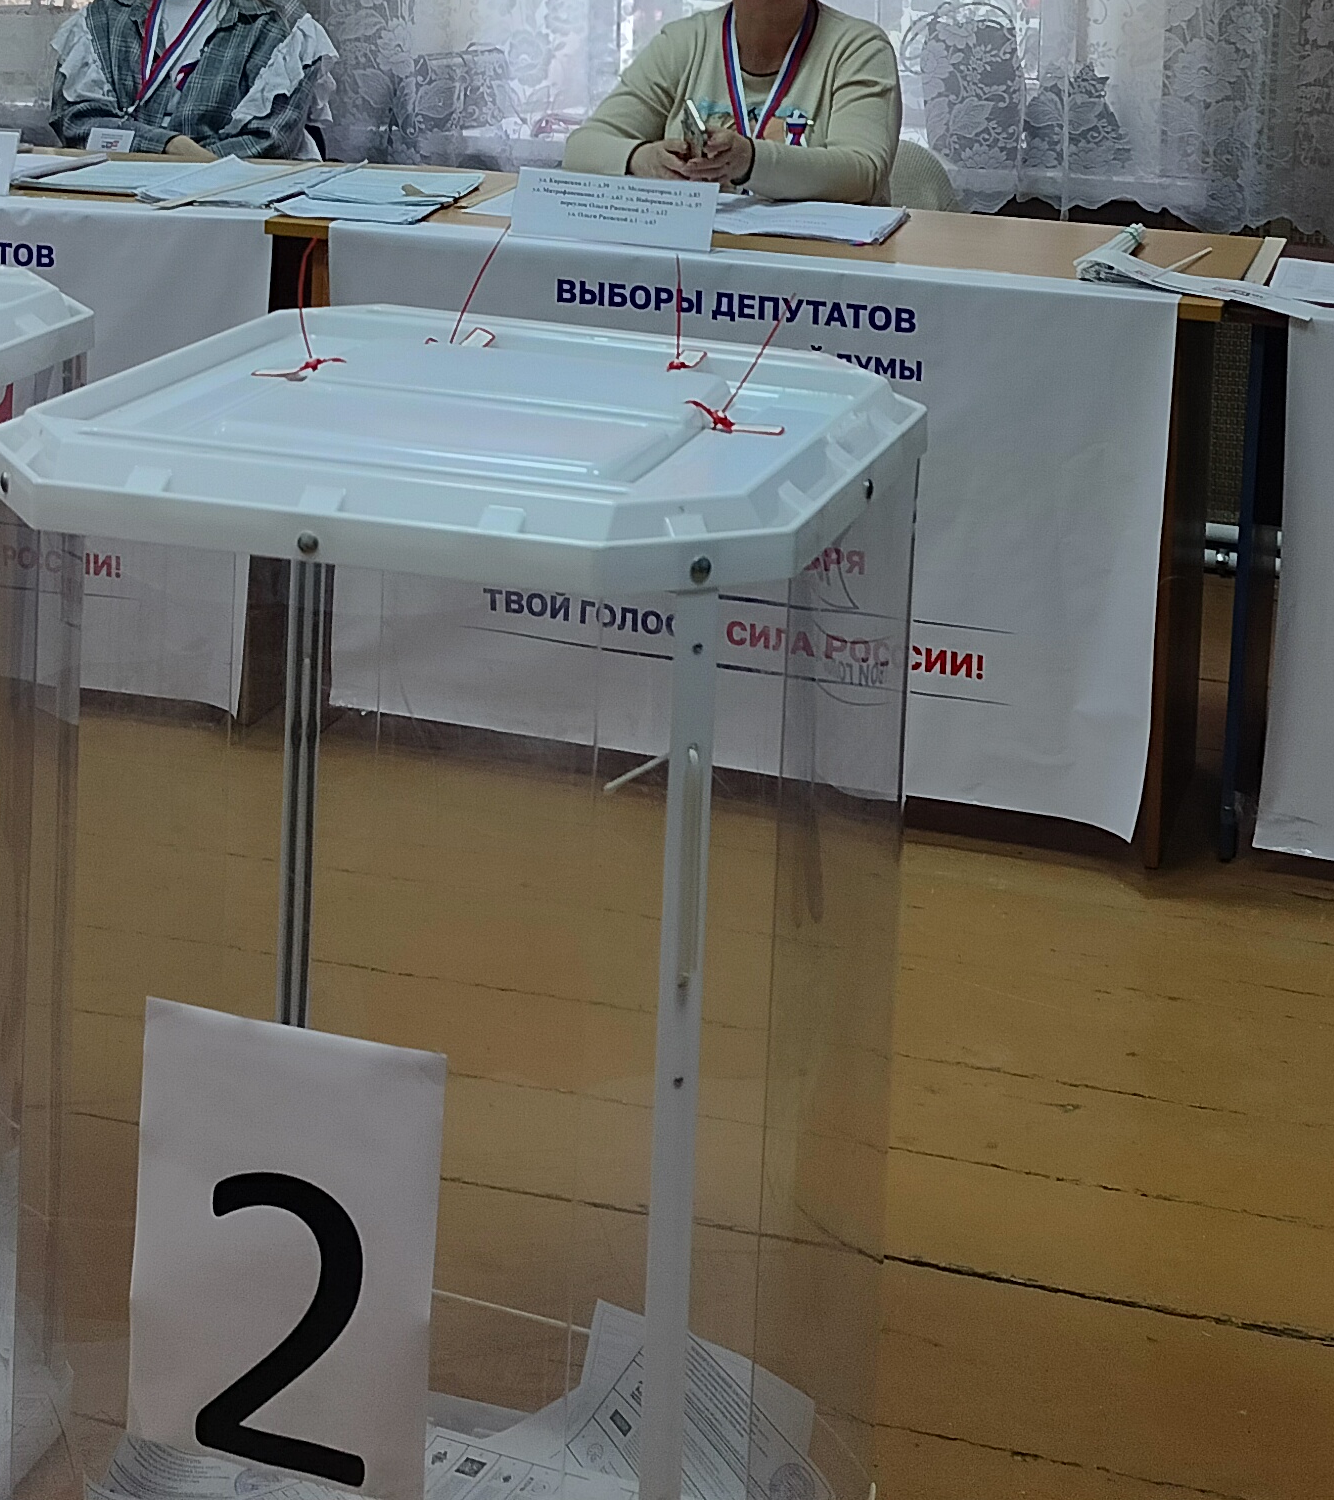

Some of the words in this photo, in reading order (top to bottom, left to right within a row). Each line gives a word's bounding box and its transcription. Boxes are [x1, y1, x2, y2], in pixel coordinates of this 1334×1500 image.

[556, 278, 702, 315] ВЫБОРЫ
[711, 292, 917, 333] ДЕПУТАТОВ
[483, 587, 570, 623] ТВОЙ
[726, 621, 815, 658] СИЛА
[195, 1171, 366, 1488] 2
